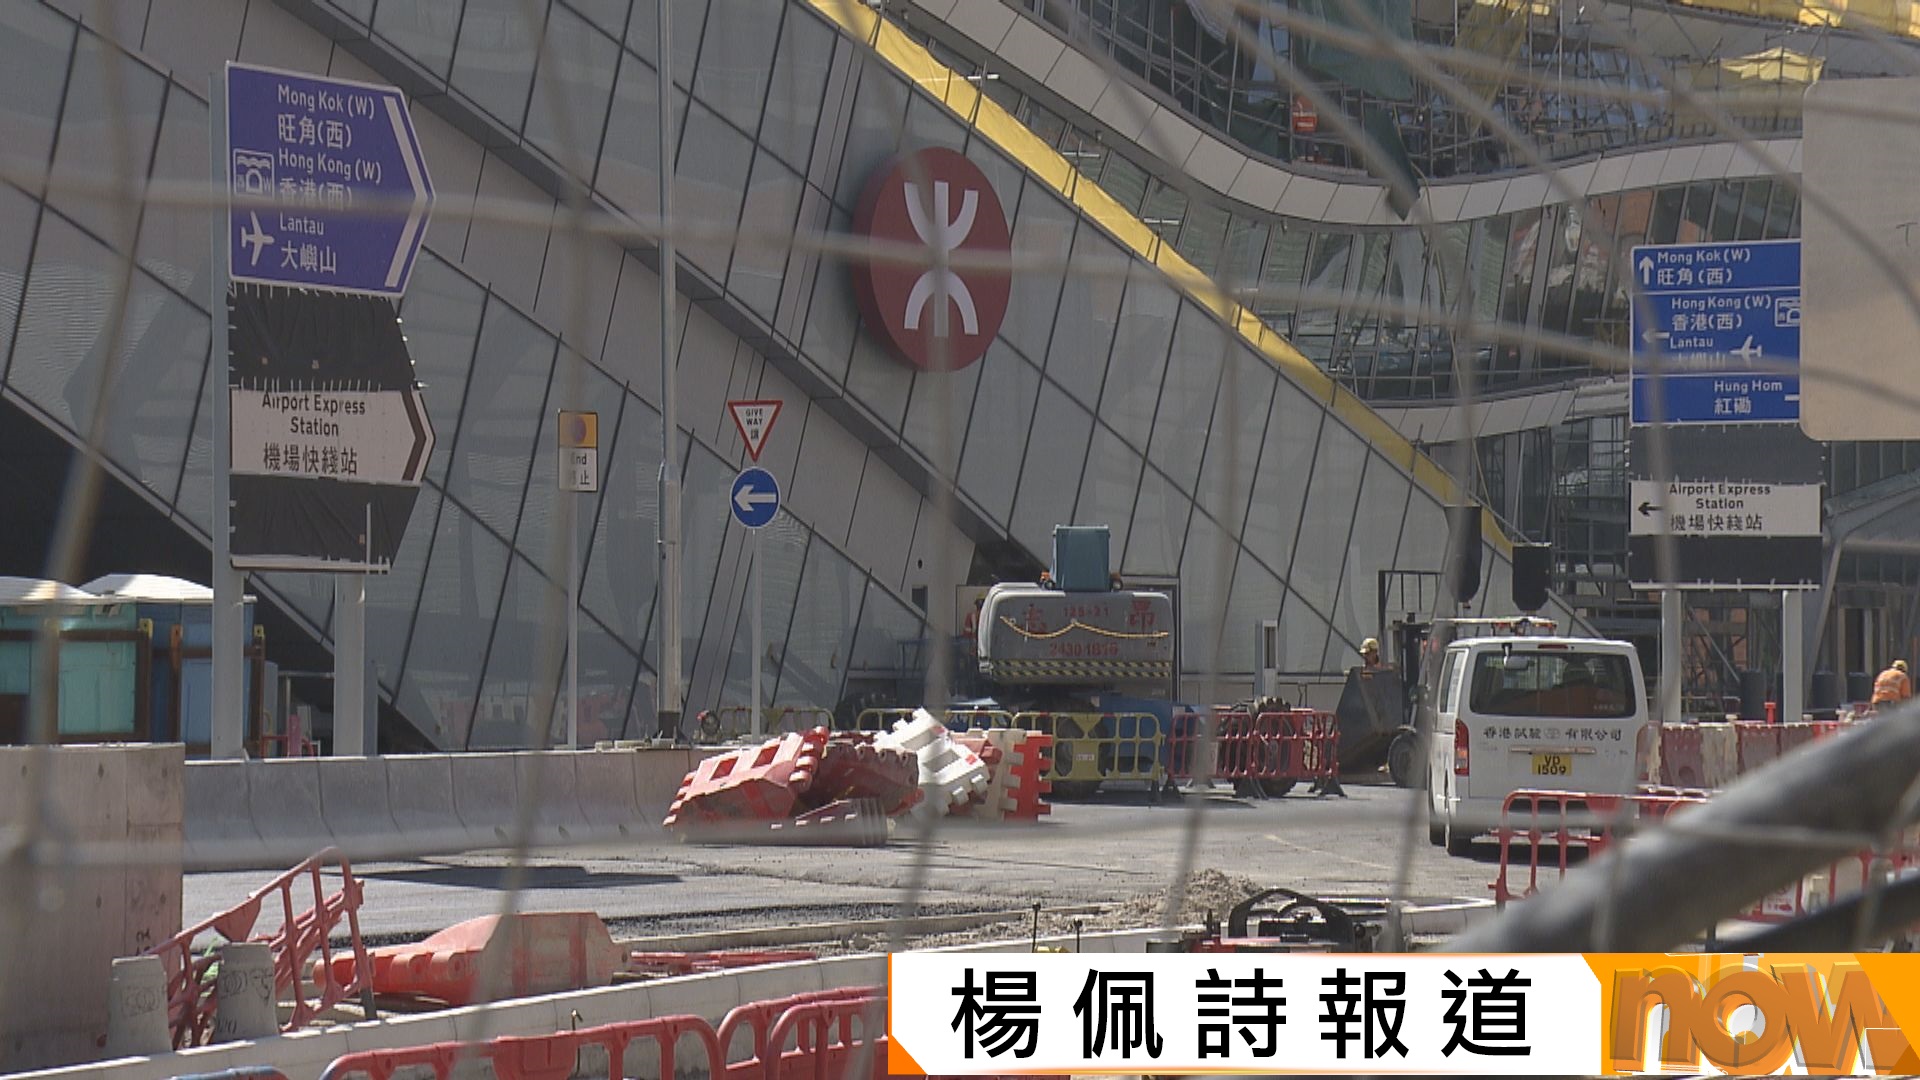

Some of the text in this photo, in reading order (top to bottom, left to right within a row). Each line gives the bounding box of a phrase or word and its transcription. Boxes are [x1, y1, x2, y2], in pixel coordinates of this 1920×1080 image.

[278, 84, 375, 120] Mong Kok (W)
[278, 114, 352, 149] 旺角(西)
[279, 148, 382, 185] Hong Kong (W)
[280, 212, 324, 236] Lantau
[280, 240, 337, 275] 大嶼山
[1657, 248, 1751, 265] Mong Kok (W)
[1657, 267, 1733, 286] 旺角(西)
[1671, 294, 1772, 311] Hong Kong (W)
[1671, 314, 1743, 332] 香港(西)
[1670, 337, 1713, 349] Lantau
[1714, 379, 1783, 393] Hung Hom
[262, 391, 366, 416] Airport Express
[745, 408, 763, 417] GIVE
[1714, 396, 1752, 415] 紅磡
[290, 416, 339, 437] Station
[263, 442, 358, 476] 機場快綫站
[1669, 484, 1771, 497] Airport Express
[1695, 498, 1744, 510] Station
[1670, 513, 1763, 532] 機場快綫站
[1537, 764, 1567, 776] 1509
